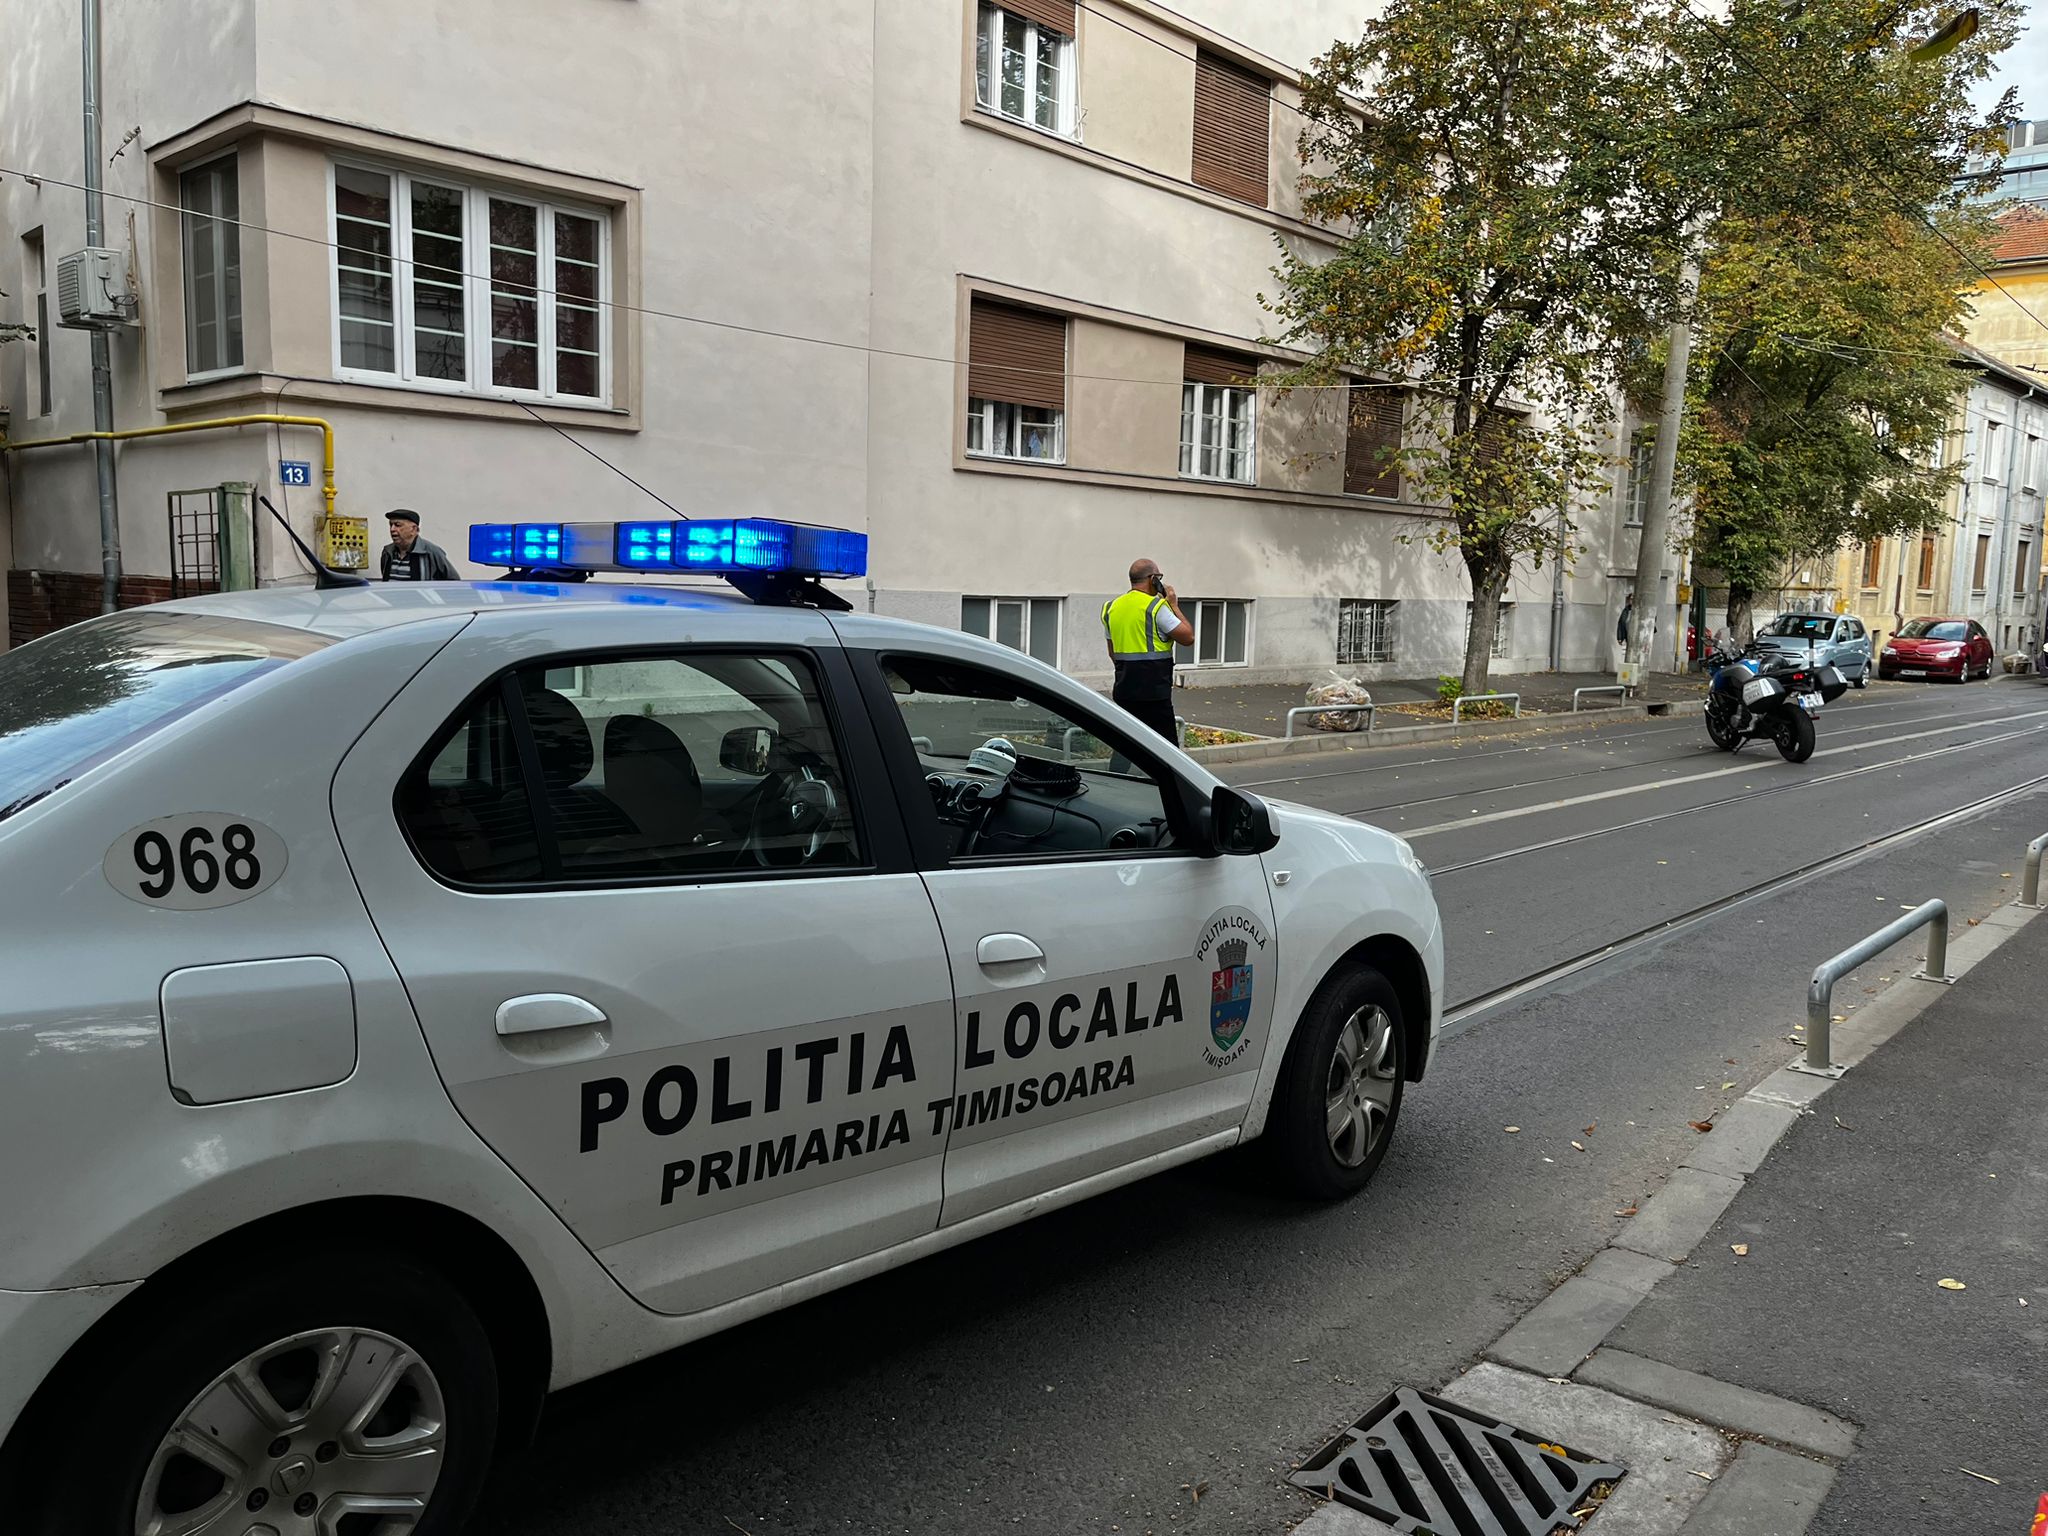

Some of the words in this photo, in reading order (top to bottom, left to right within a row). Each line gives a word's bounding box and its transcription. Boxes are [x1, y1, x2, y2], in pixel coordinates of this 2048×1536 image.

[285, 467, 304, 483] 13
[133, 823, 261, 899] 968
[579, 1024, 917, 1154] POLITIA
[964, 973, 1184, 1070] LOCALA
[660, 1108, 911, 1206] PRIMARIA
[927, 1054, 1135, 1136] TIMISOARA
